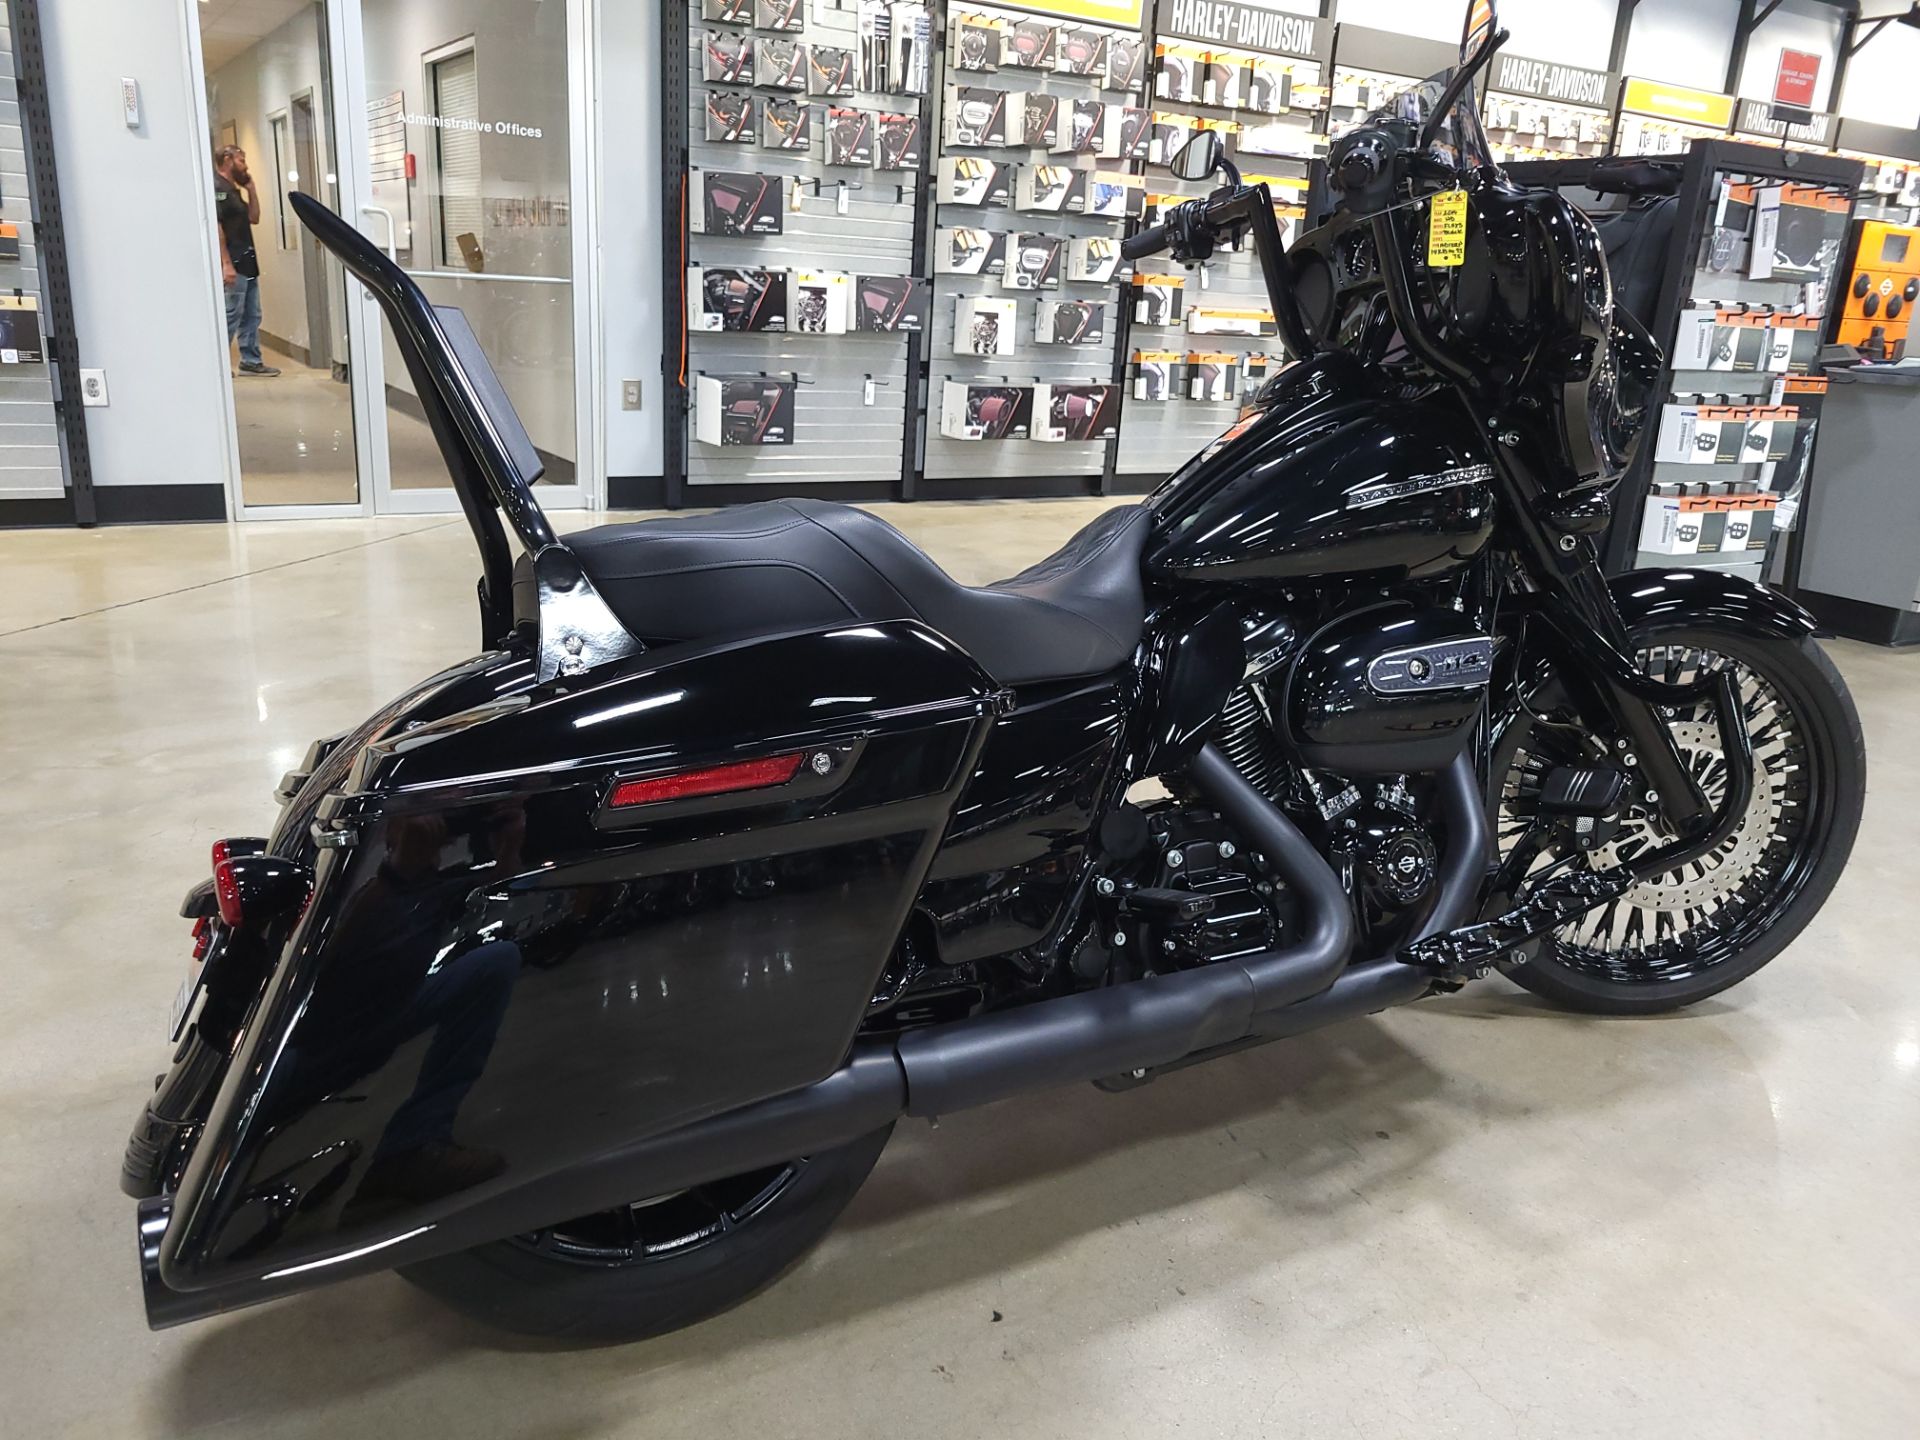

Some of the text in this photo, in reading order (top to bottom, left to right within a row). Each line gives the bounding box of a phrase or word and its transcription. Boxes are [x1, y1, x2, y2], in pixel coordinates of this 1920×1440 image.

[1170, 0, 1316, 56] HARLEY-DAVIDSON
[1499, 56, 1608, 105] HARLEY-DAVIDSON
[396, 111, 543, 138] Administrative Offices
